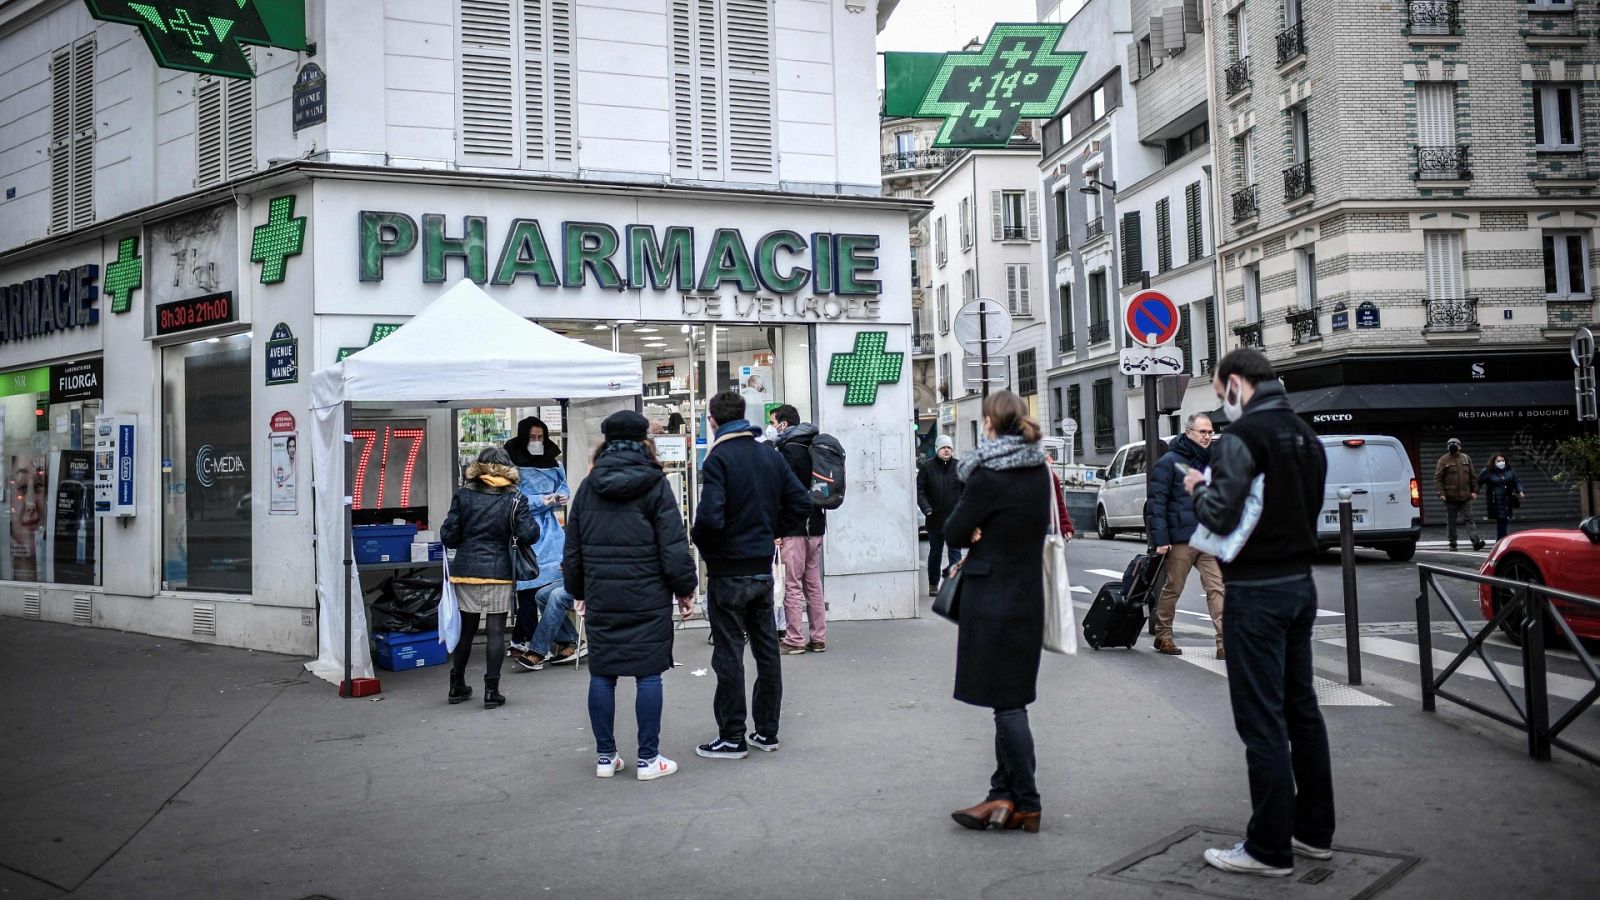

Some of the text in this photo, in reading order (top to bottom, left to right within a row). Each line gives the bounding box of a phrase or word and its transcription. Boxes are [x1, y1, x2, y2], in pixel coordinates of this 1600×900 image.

[358, 210, 883, 295] PHARMACIE
[161, 298, 228, 329] 8h30 à 21h00
[682, 294, 723, 318] DE
[270, 345, 293, 359] AVENUE
[59, 372, 98, 391] FILORGA
[271, 366, 291, 379] MAINE
[1313, 413, 1353, 423] severo
[1458, 410, 1514, 418] RESTAURANT
[1526, 409, 1569, 417] BOUCHER
[203, 455, 246, 473] C-MEDIA
[350, 424, 424, 511] 7/7
